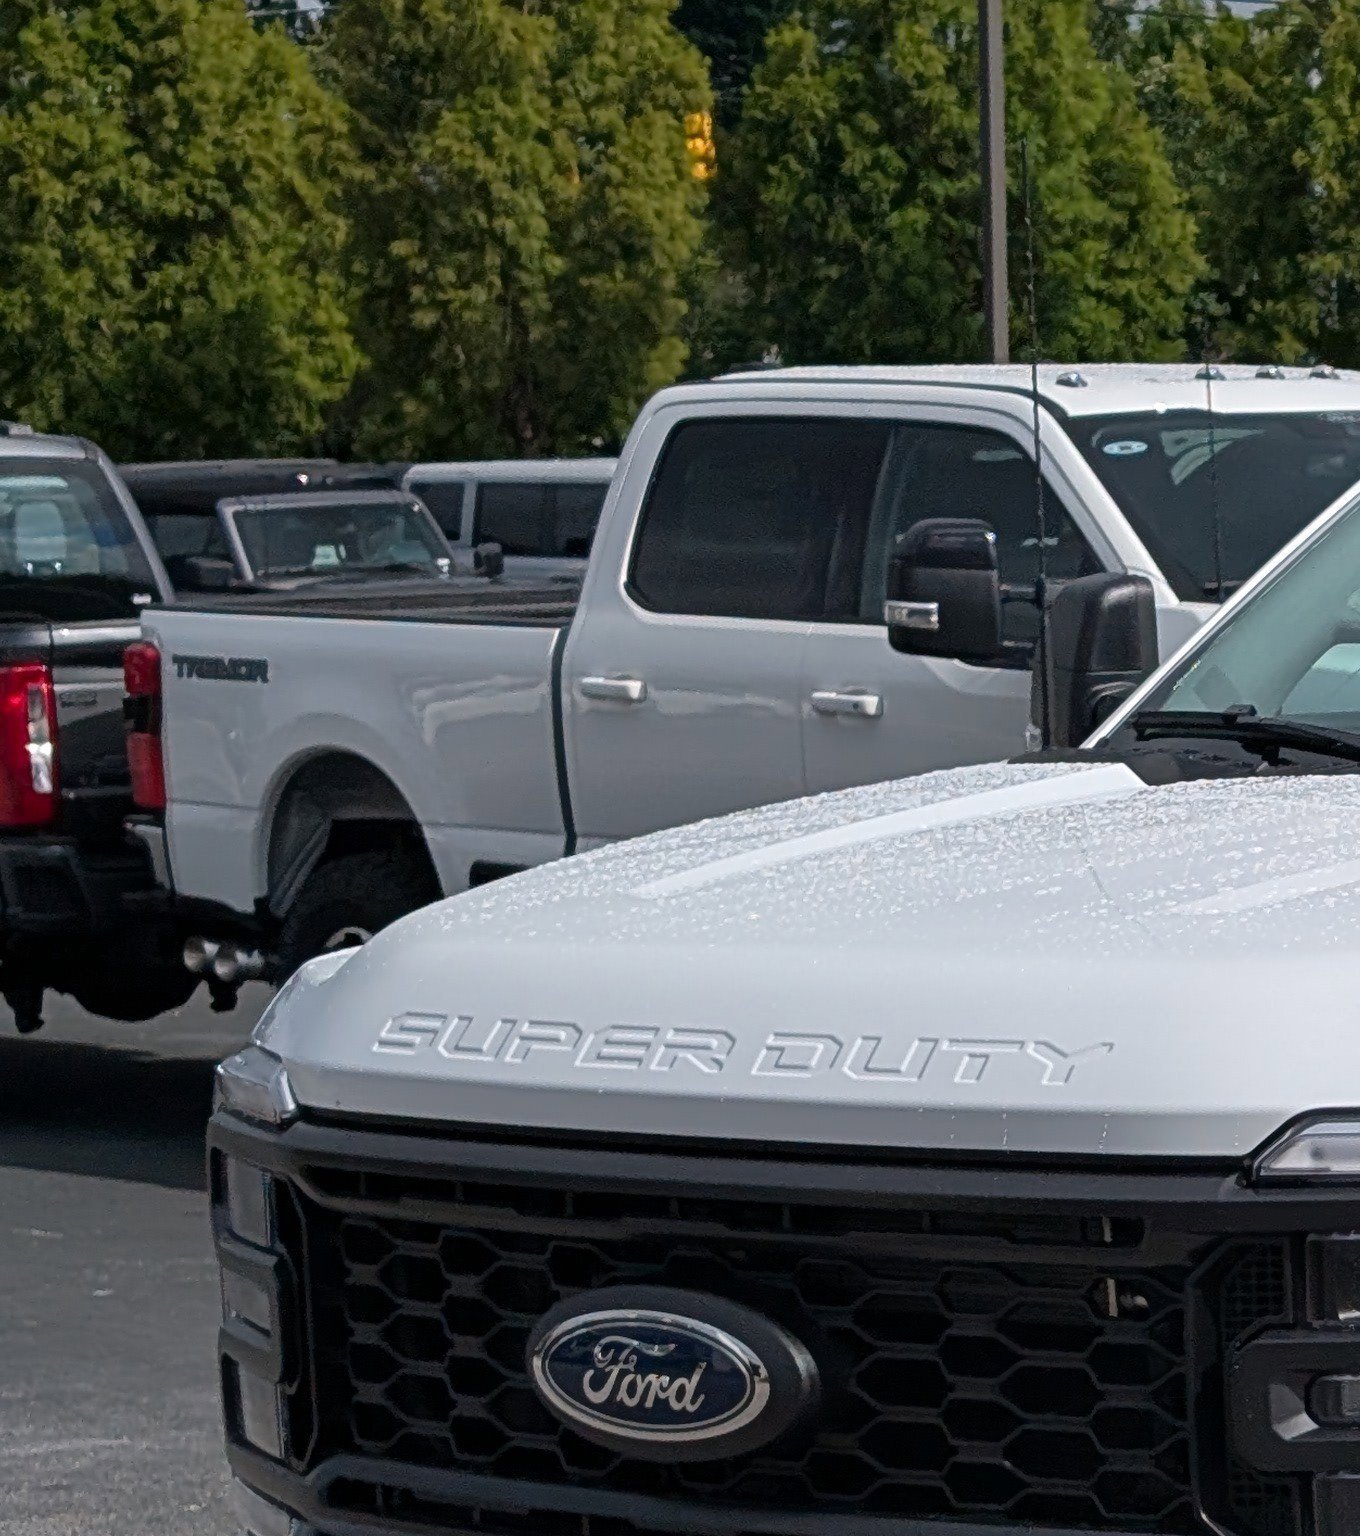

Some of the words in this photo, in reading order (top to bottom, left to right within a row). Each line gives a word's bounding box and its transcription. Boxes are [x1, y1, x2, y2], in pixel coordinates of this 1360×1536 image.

[371, 1010, 738, 1075] SUPER
[750, 1030, 1115, 1086] DUTY
[582, 1335, 706, 1413] Ford
